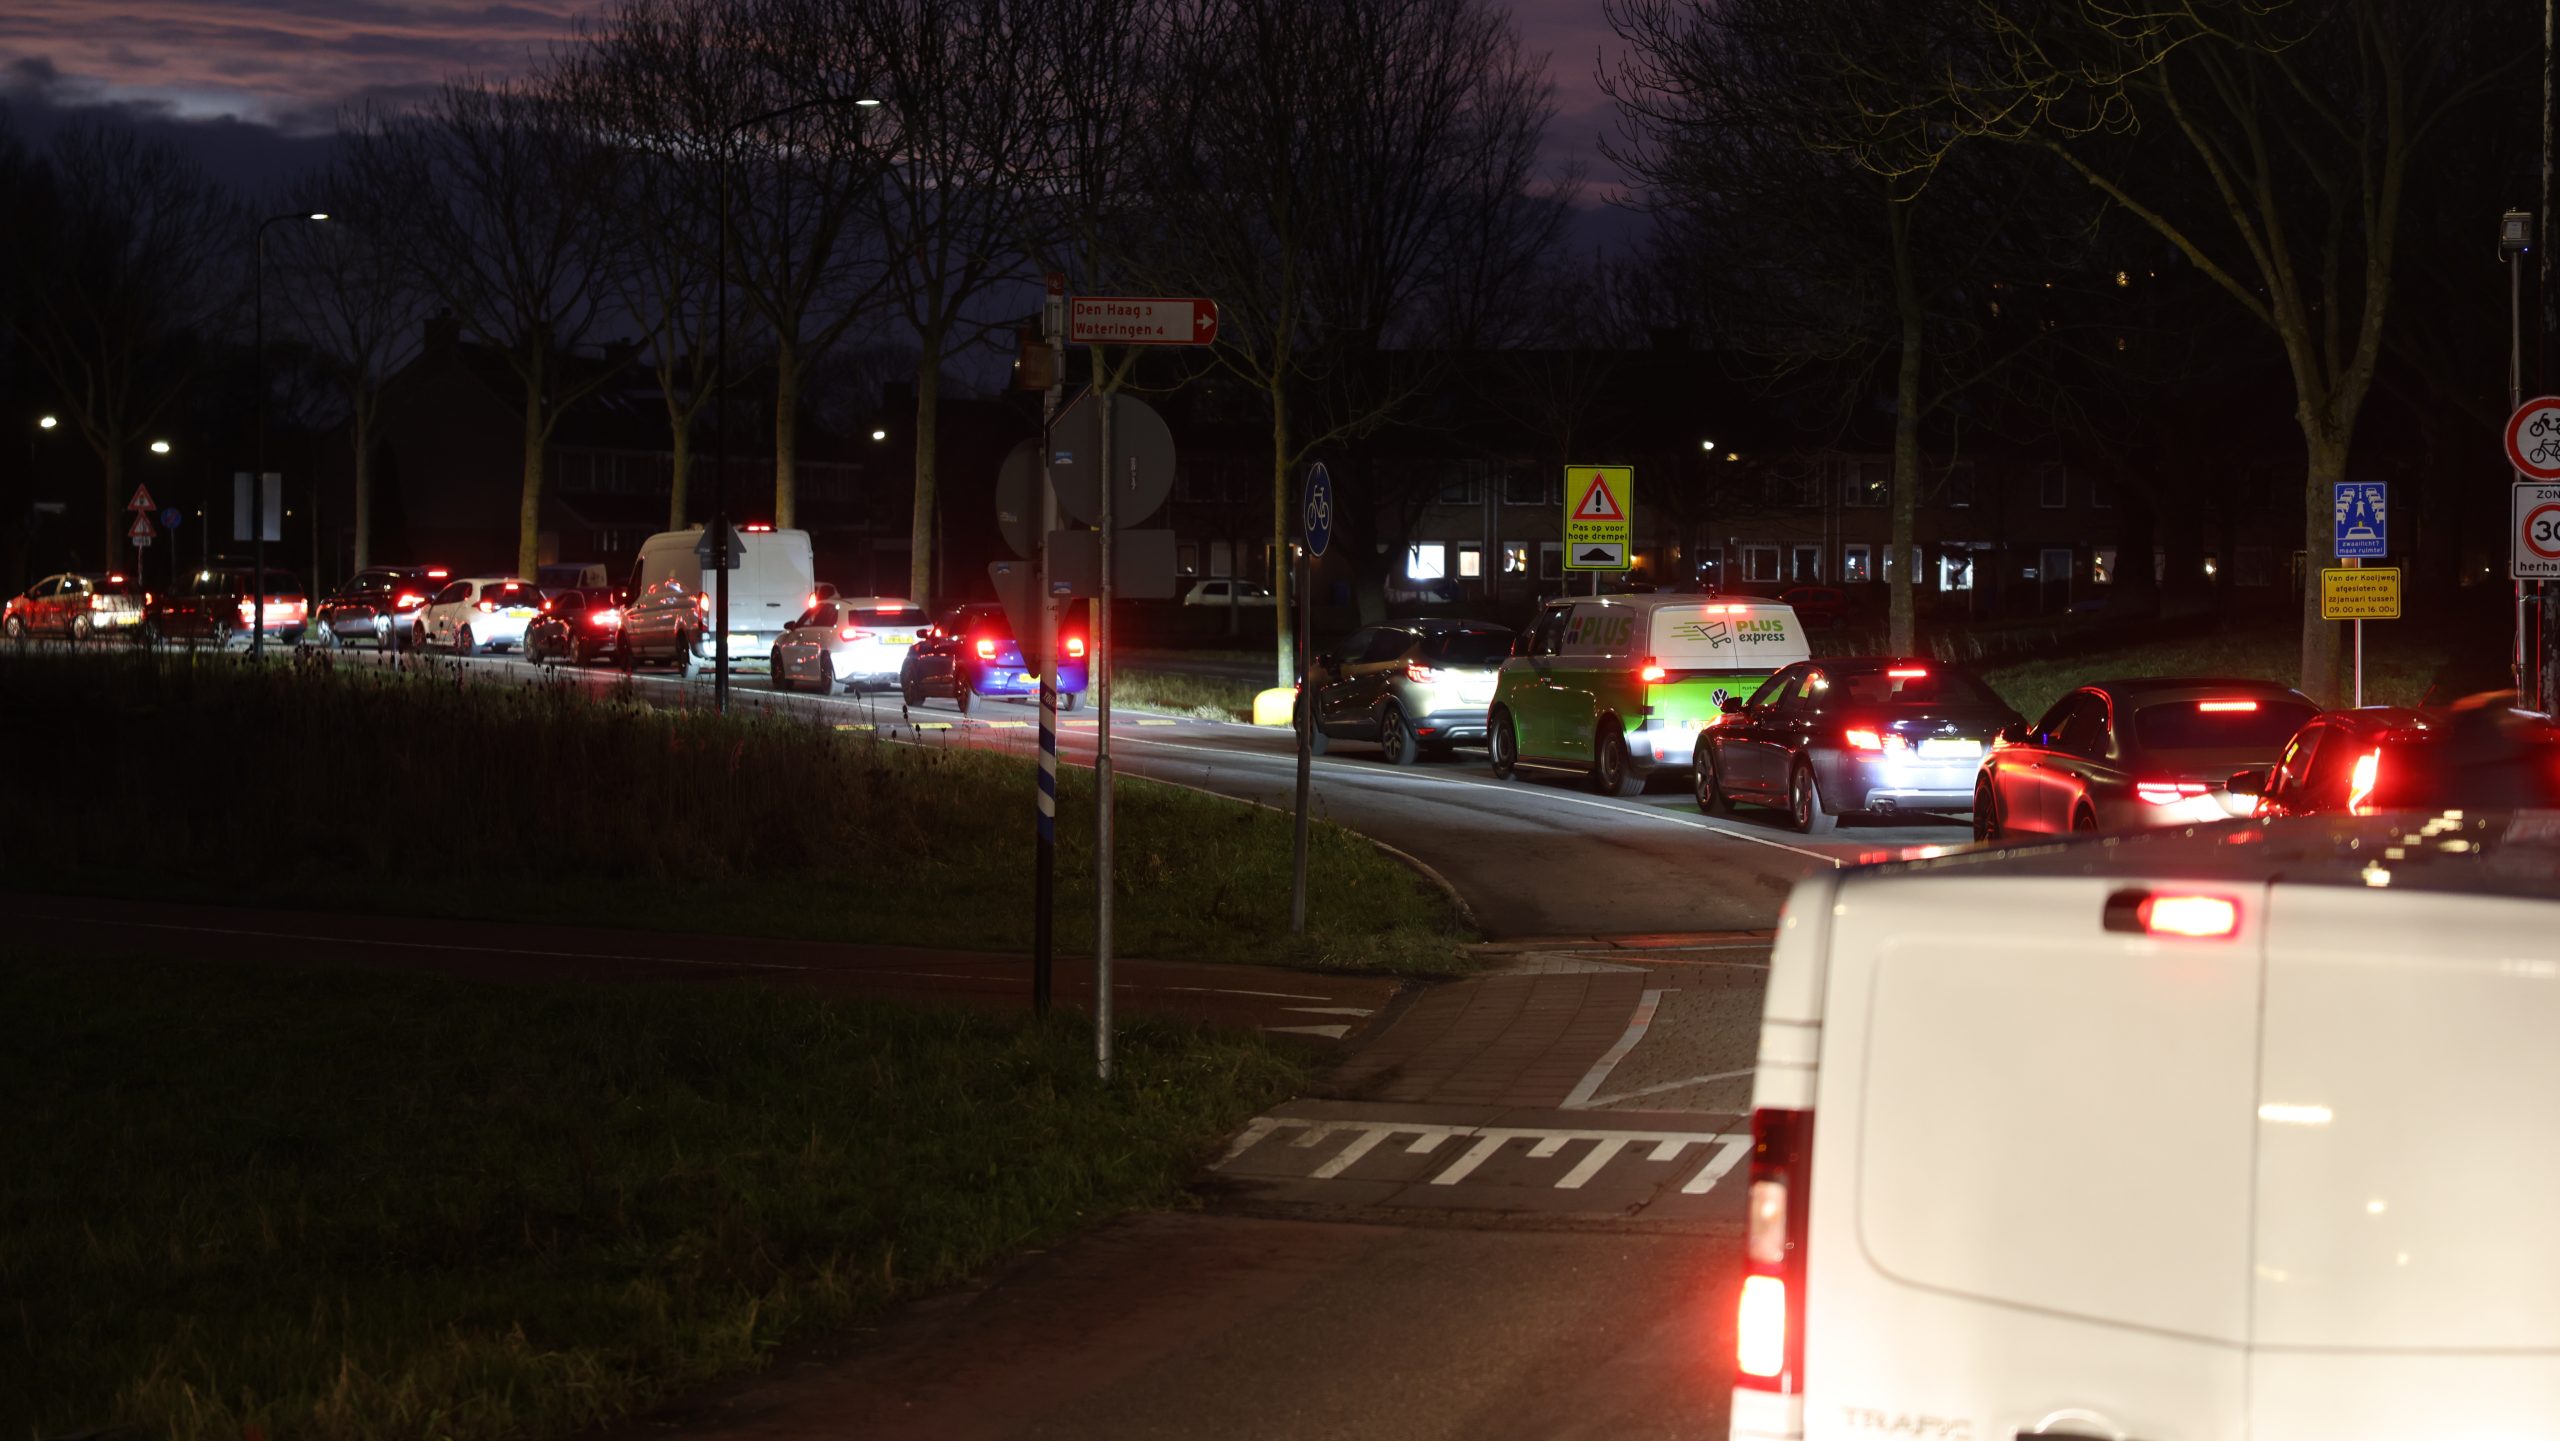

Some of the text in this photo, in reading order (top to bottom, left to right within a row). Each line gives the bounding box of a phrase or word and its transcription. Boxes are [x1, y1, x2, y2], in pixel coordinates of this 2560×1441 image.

[1076, 303, 1152, 319] Den Haag 3
[1075, 322, 1164, 337] Wateringen 4
[1572, 523, 1589, 531] Pas
[1568, 533, 1628, 541] hoge drempel
[2360, 574, 2396, 582] Kooijweg
[2335, 585, 2376, 593] afgesloten
[1579, 616, 1633, 646] PLUS
[1735, 619, 1783, 633] PLUS
[1738, 631, 1786, 644] express
